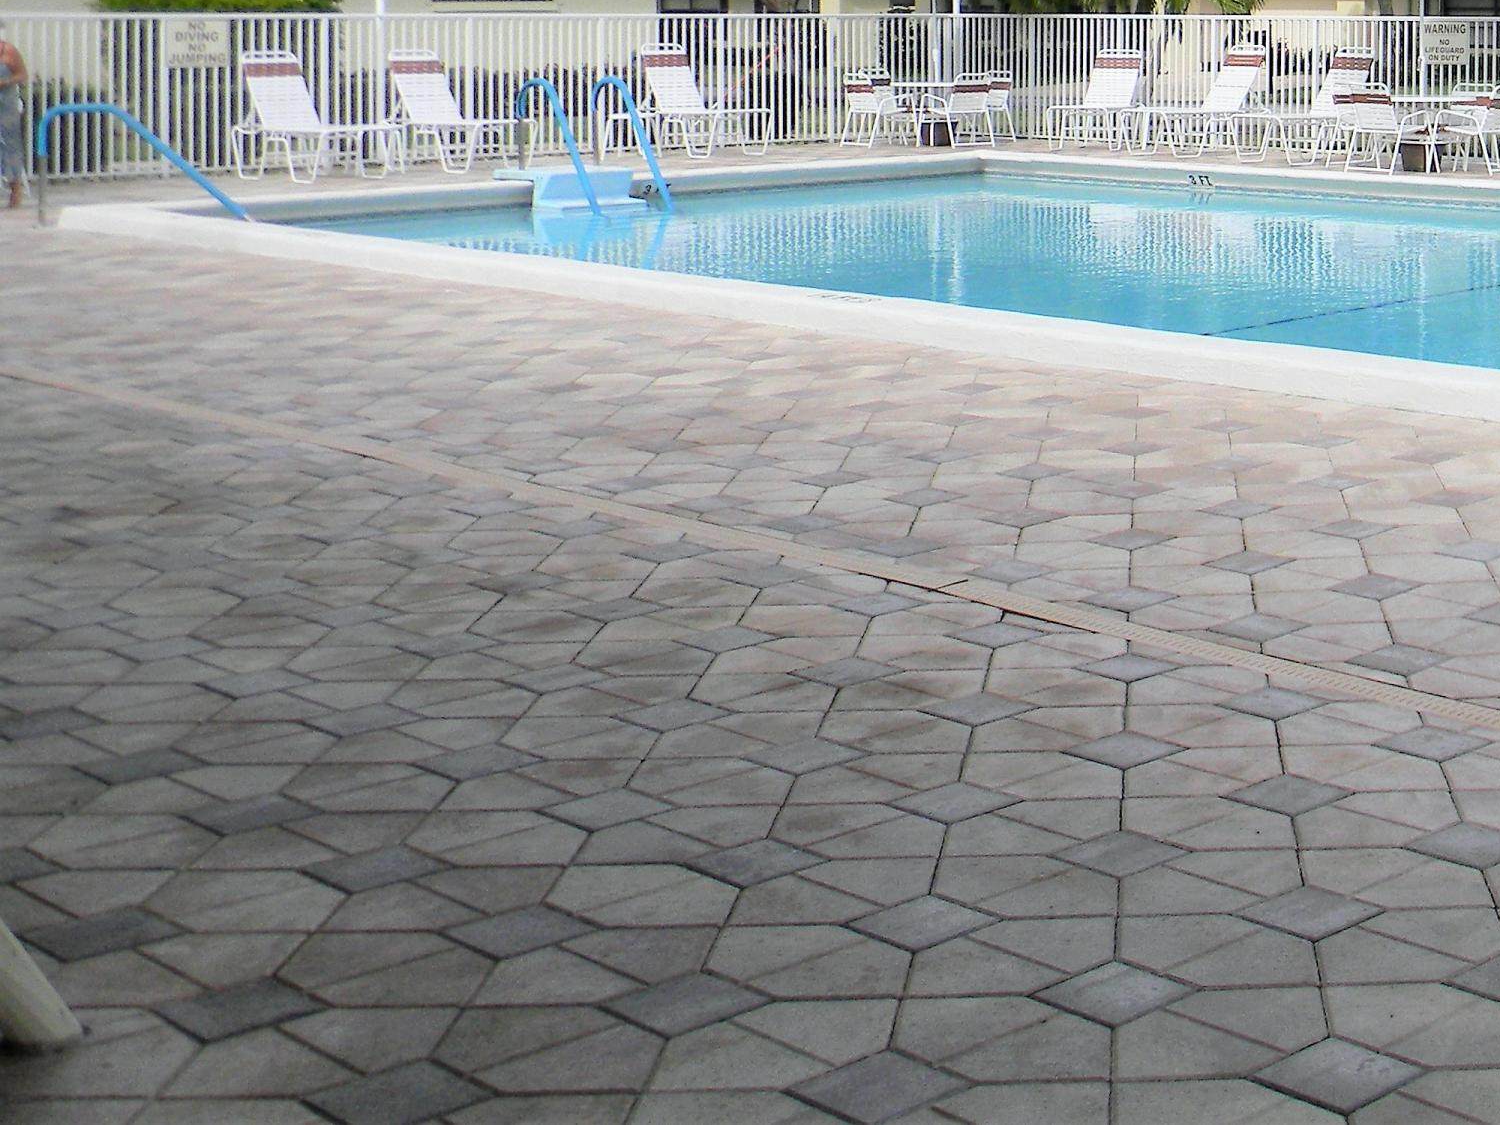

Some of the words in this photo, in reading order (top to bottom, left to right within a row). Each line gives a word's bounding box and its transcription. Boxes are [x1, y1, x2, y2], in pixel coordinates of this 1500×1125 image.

[187, 20, 206, 31] NO
[1424, 23, 1466, 34] WARNING
[175, 31, 219, 43] DIVING
[188, 43, 206, 53] NO
[168, 53, 226, 65] JUMPING
[1440, 54, 1460, 62] DUTY
[1188, 175, 1197, 185] 3
